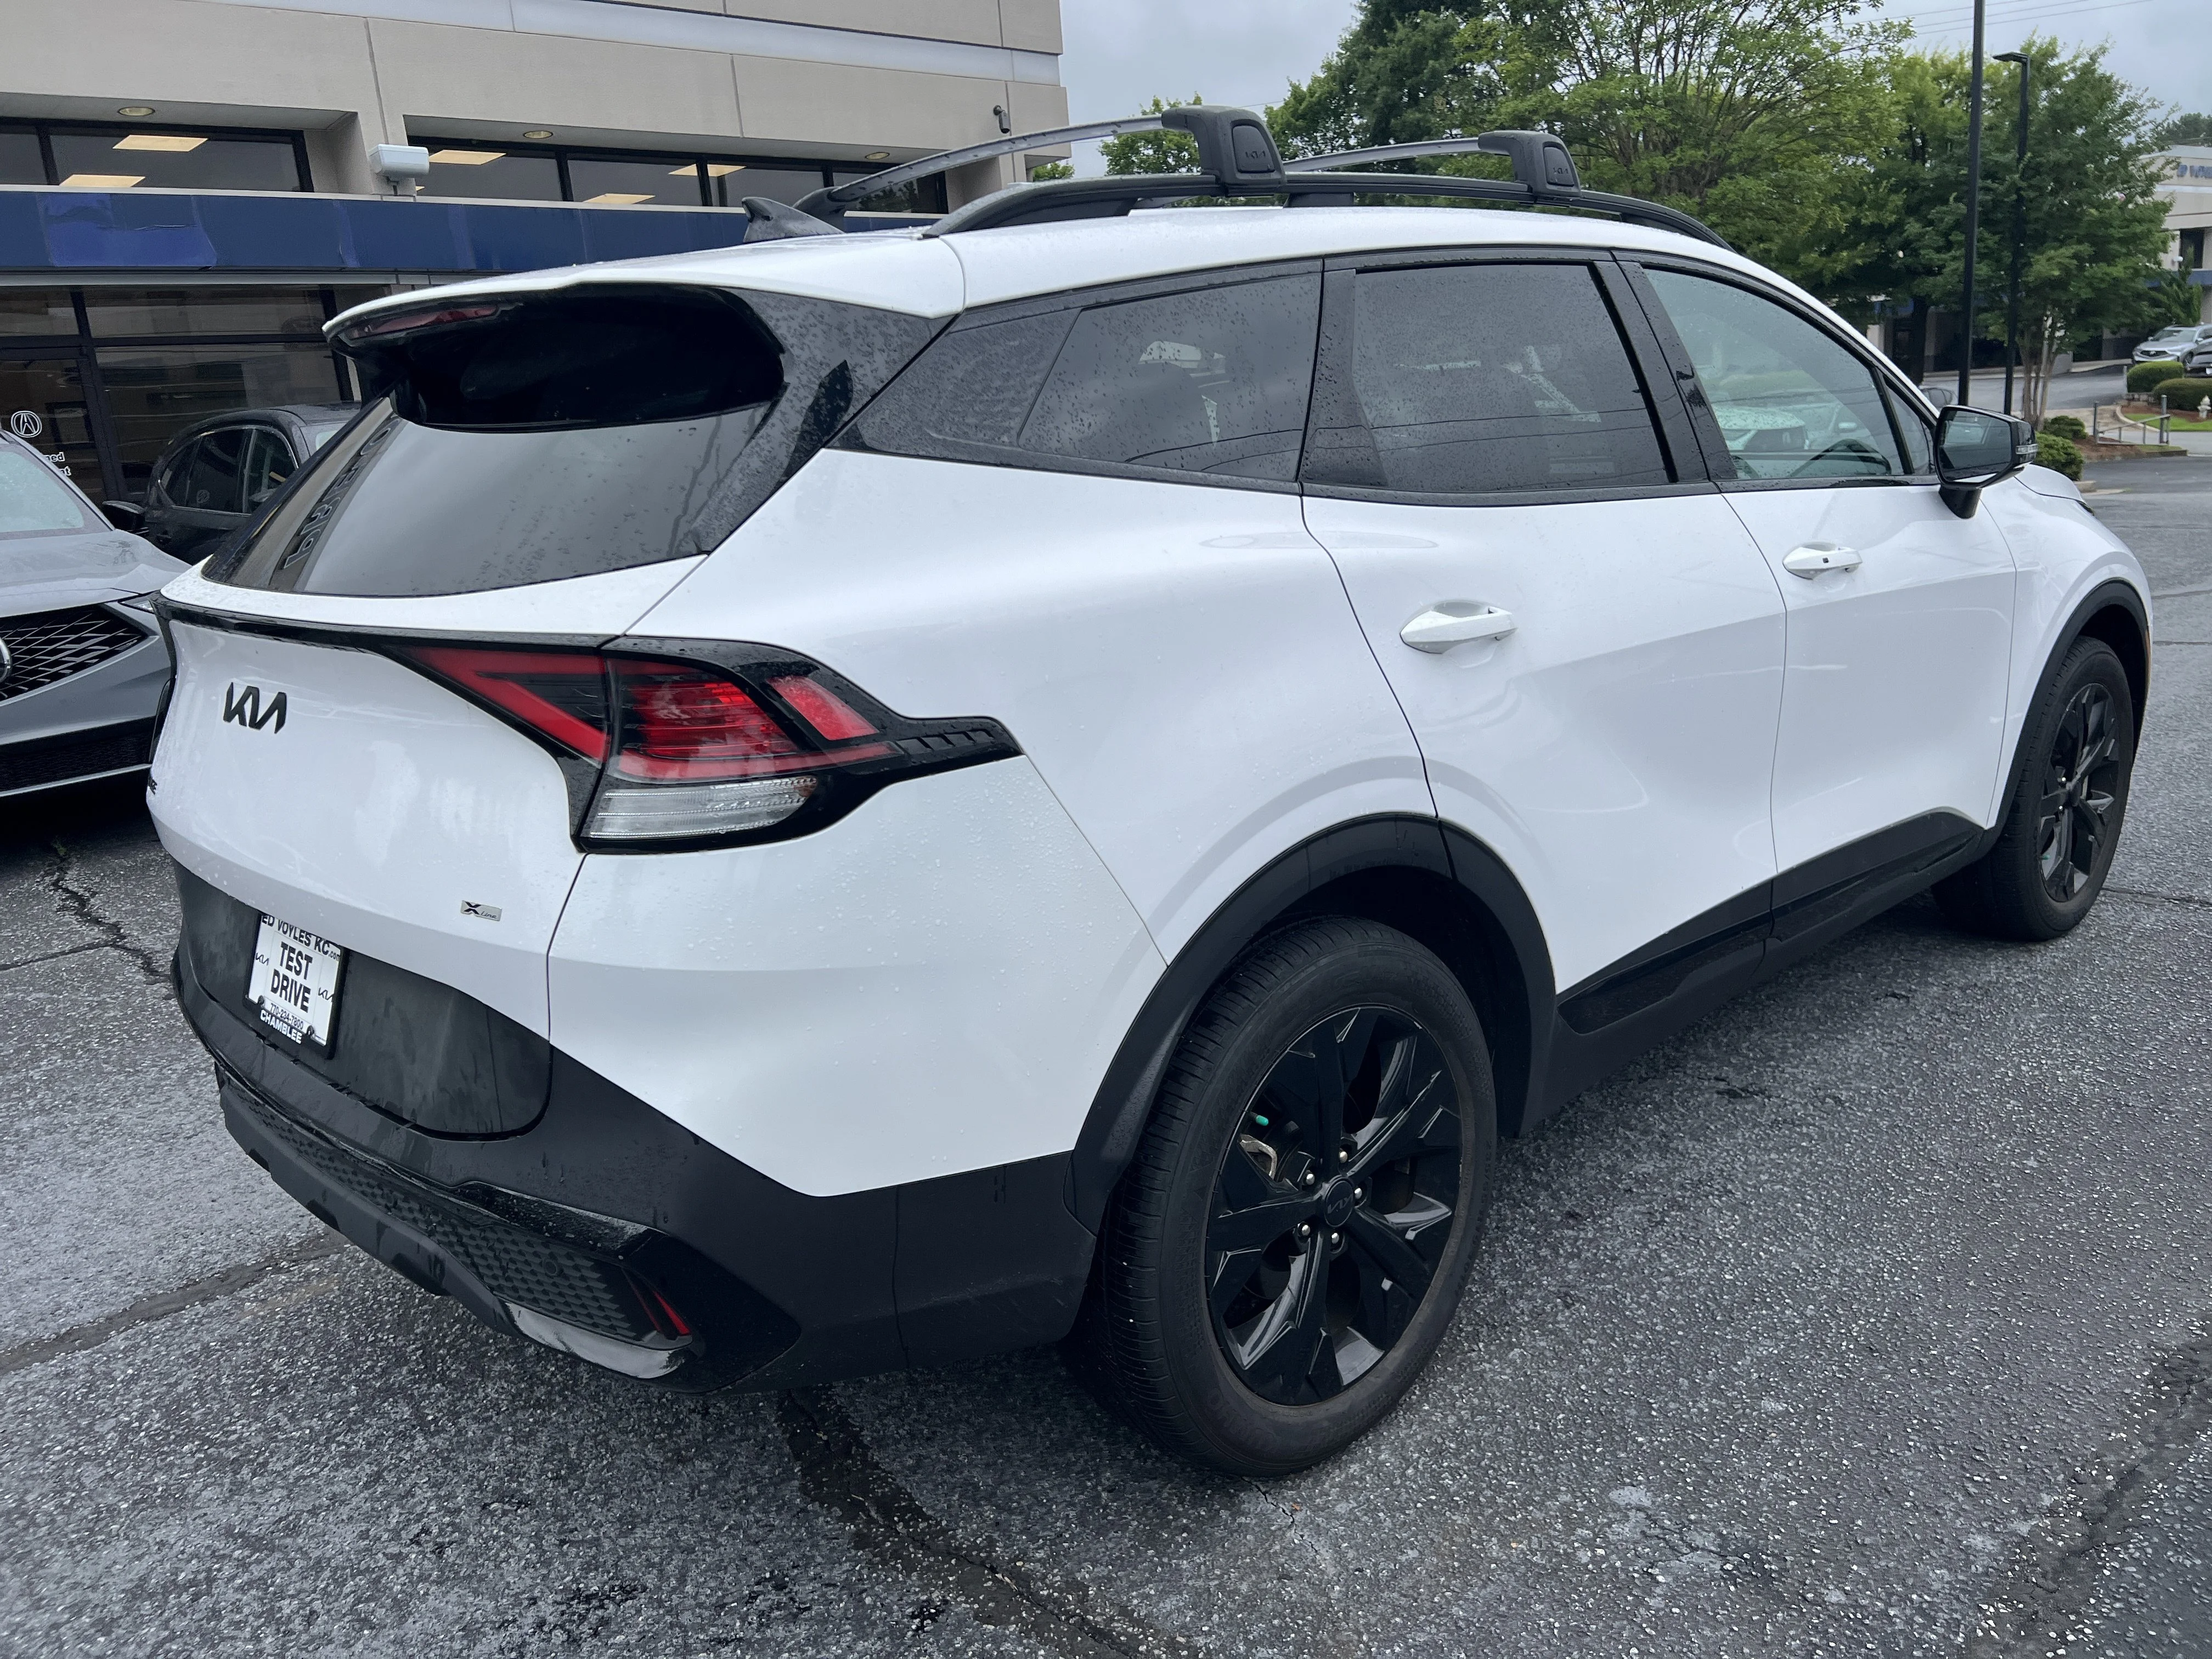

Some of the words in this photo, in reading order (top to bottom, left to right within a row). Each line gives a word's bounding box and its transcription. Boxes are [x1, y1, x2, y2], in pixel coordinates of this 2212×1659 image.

[223, 682, 287, 734] KIA
[262, 915, 275, 927] ED
[278, 919, 312, 947] VOYLES
[279, 941, 313, 980] TEST
[270, 968, 312, 1013] DRIVE
[260, 1009, 303, 1045] CHAMBLEE
